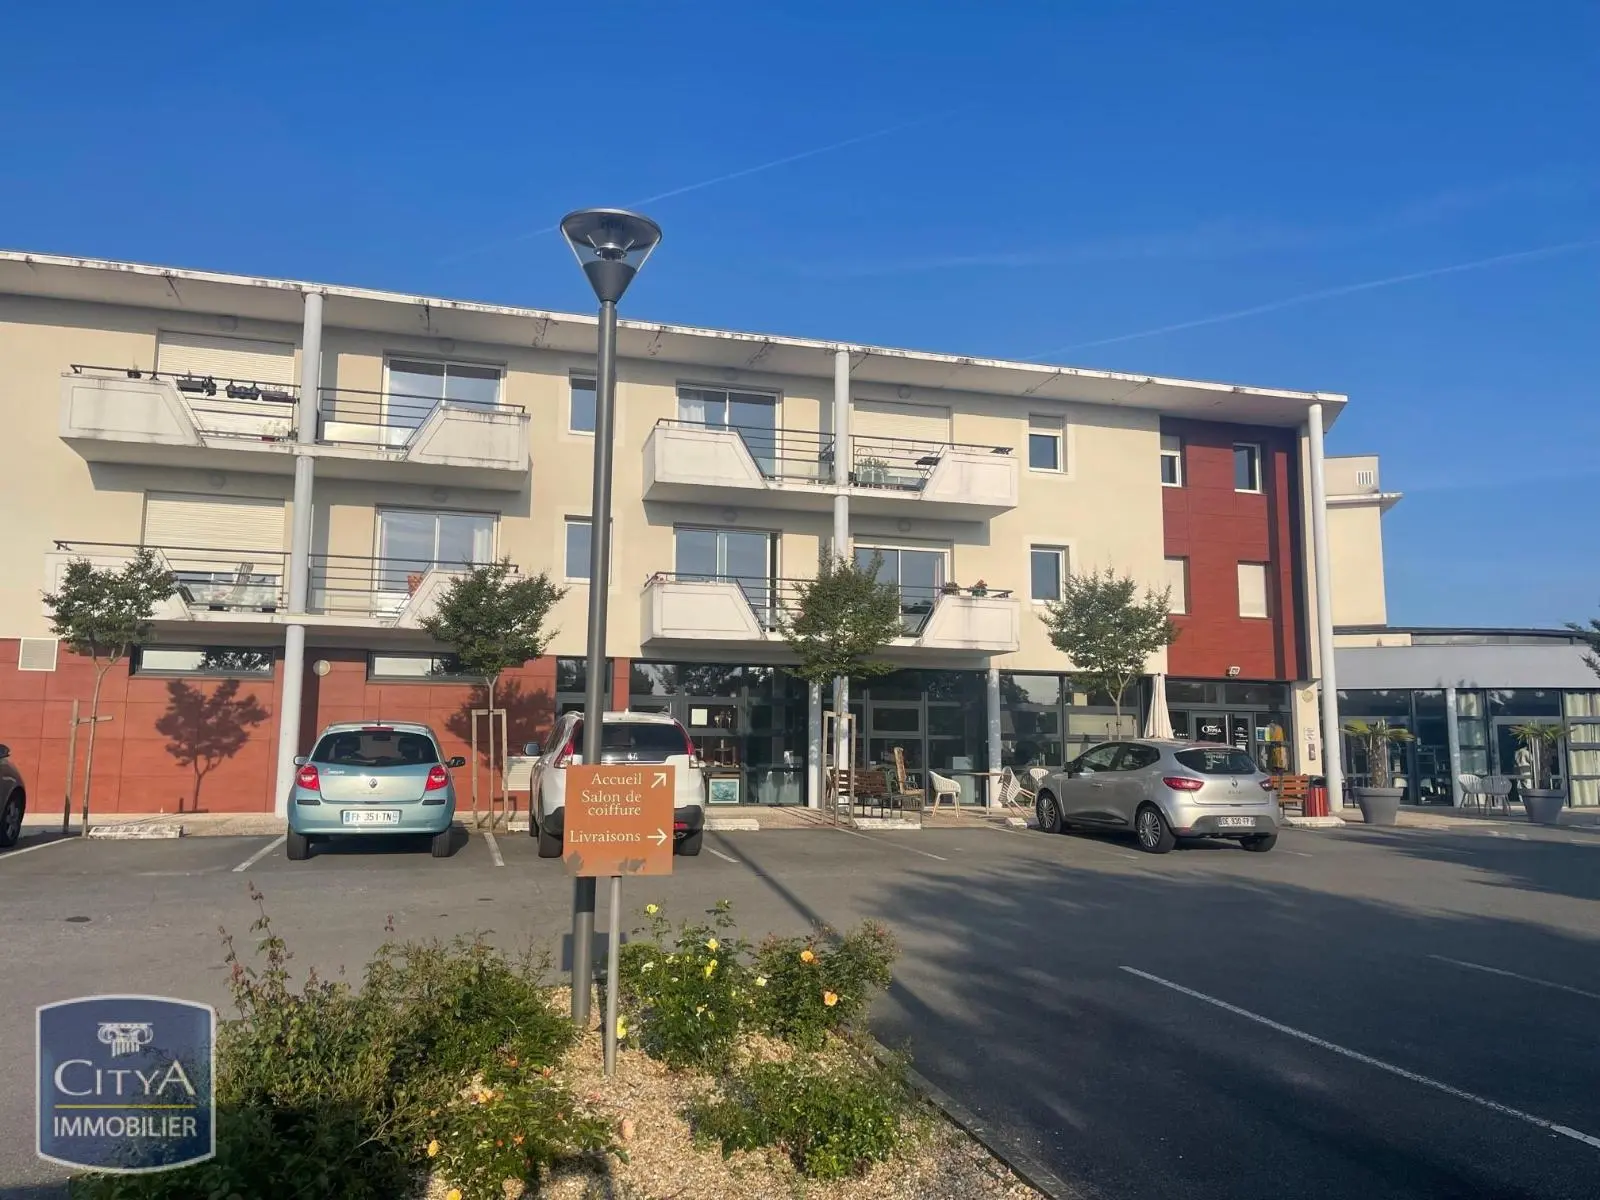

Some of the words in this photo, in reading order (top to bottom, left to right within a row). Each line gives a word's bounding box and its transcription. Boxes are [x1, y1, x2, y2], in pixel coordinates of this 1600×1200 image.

[591, 772, 642, 785] Accueil
[581, 789, 621, 803] Salon
[625, 790, 642, 803] de
[587, 803, 641, 816] coiffure
[567, 829, 641, 844] Livraisons
